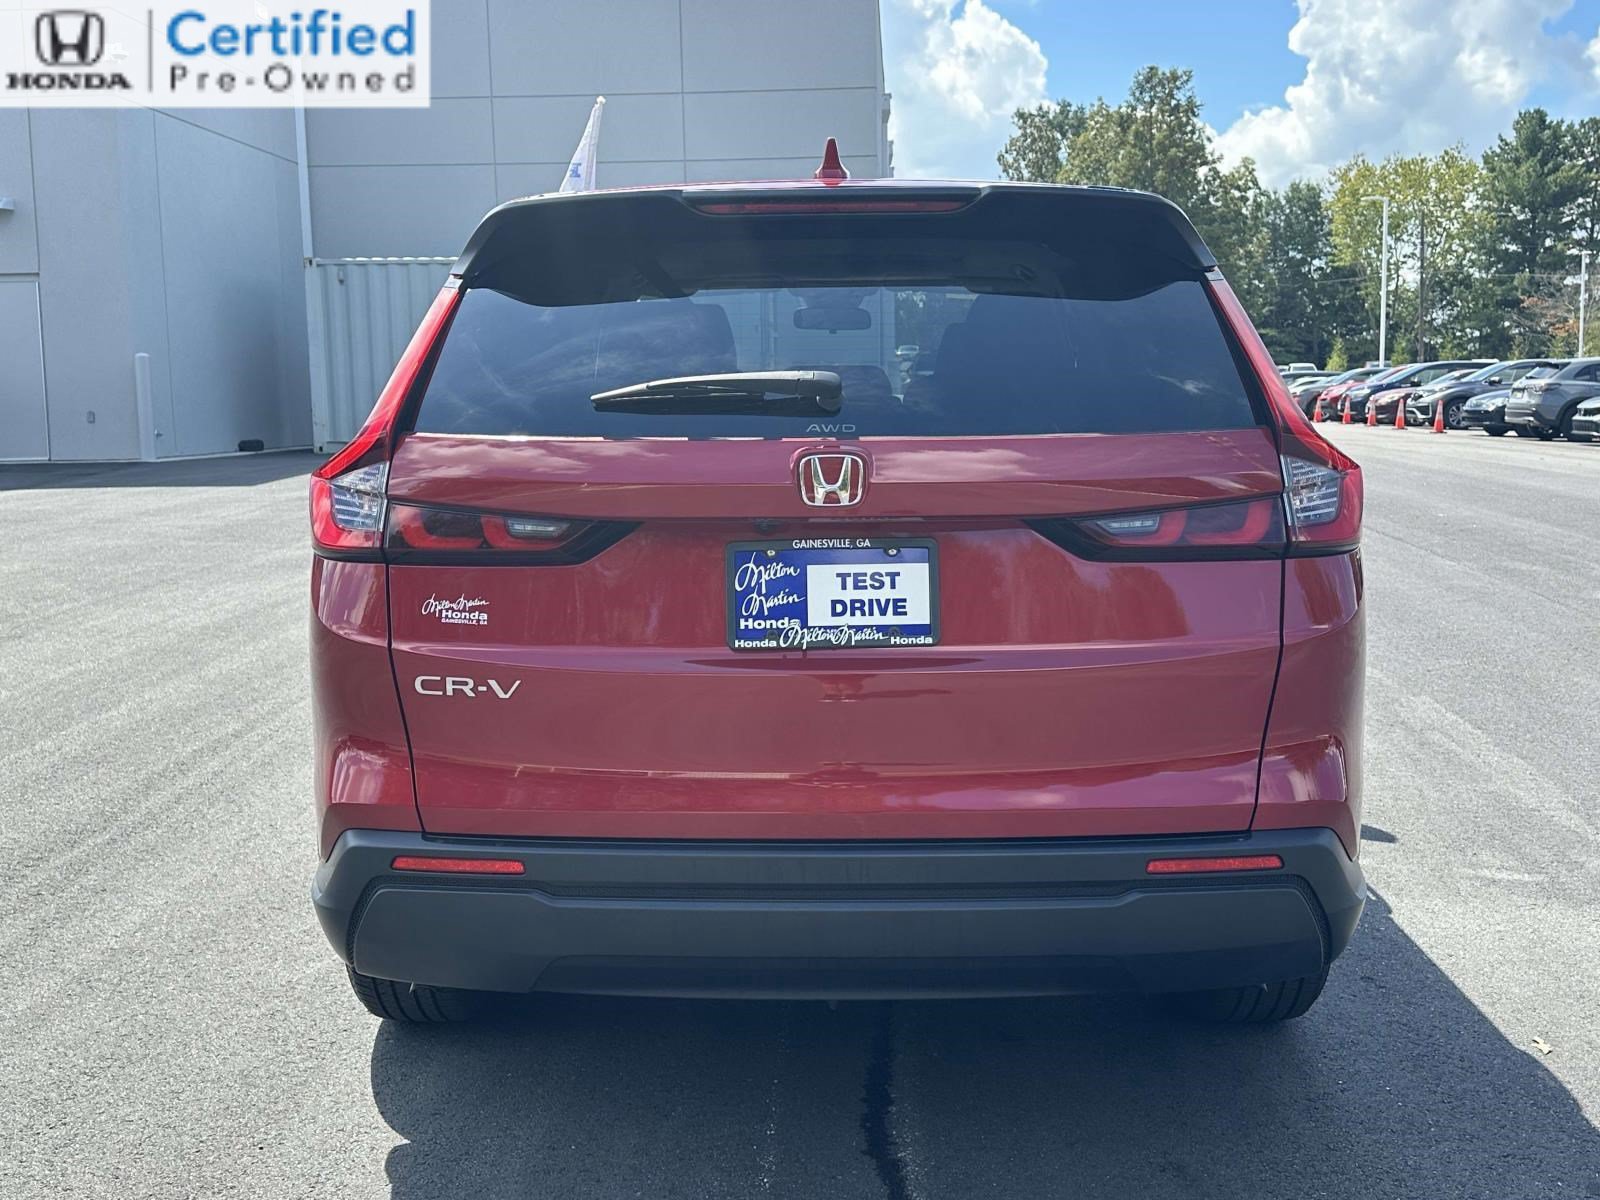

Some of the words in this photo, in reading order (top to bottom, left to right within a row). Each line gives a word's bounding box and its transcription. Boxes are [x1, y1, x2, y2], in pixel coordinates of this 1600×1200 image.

[806, 424, 856, 432] AWD
[792, 539, 853, 548] GAINESVILLE,
[856, 538, 871, 547] GA
[735, 552, 800, 594] Milton
[836, 571, 900, 590] TEST
[742, 585, 806, 616] Martin
[830, 598, 907, 617] DRIVE
[441, 609, 488, 620] Honda
[735, 639, 777, 648] Honda
[890, 635, 933, 645] Honda
[414, 675, 522, 699] CR-V
